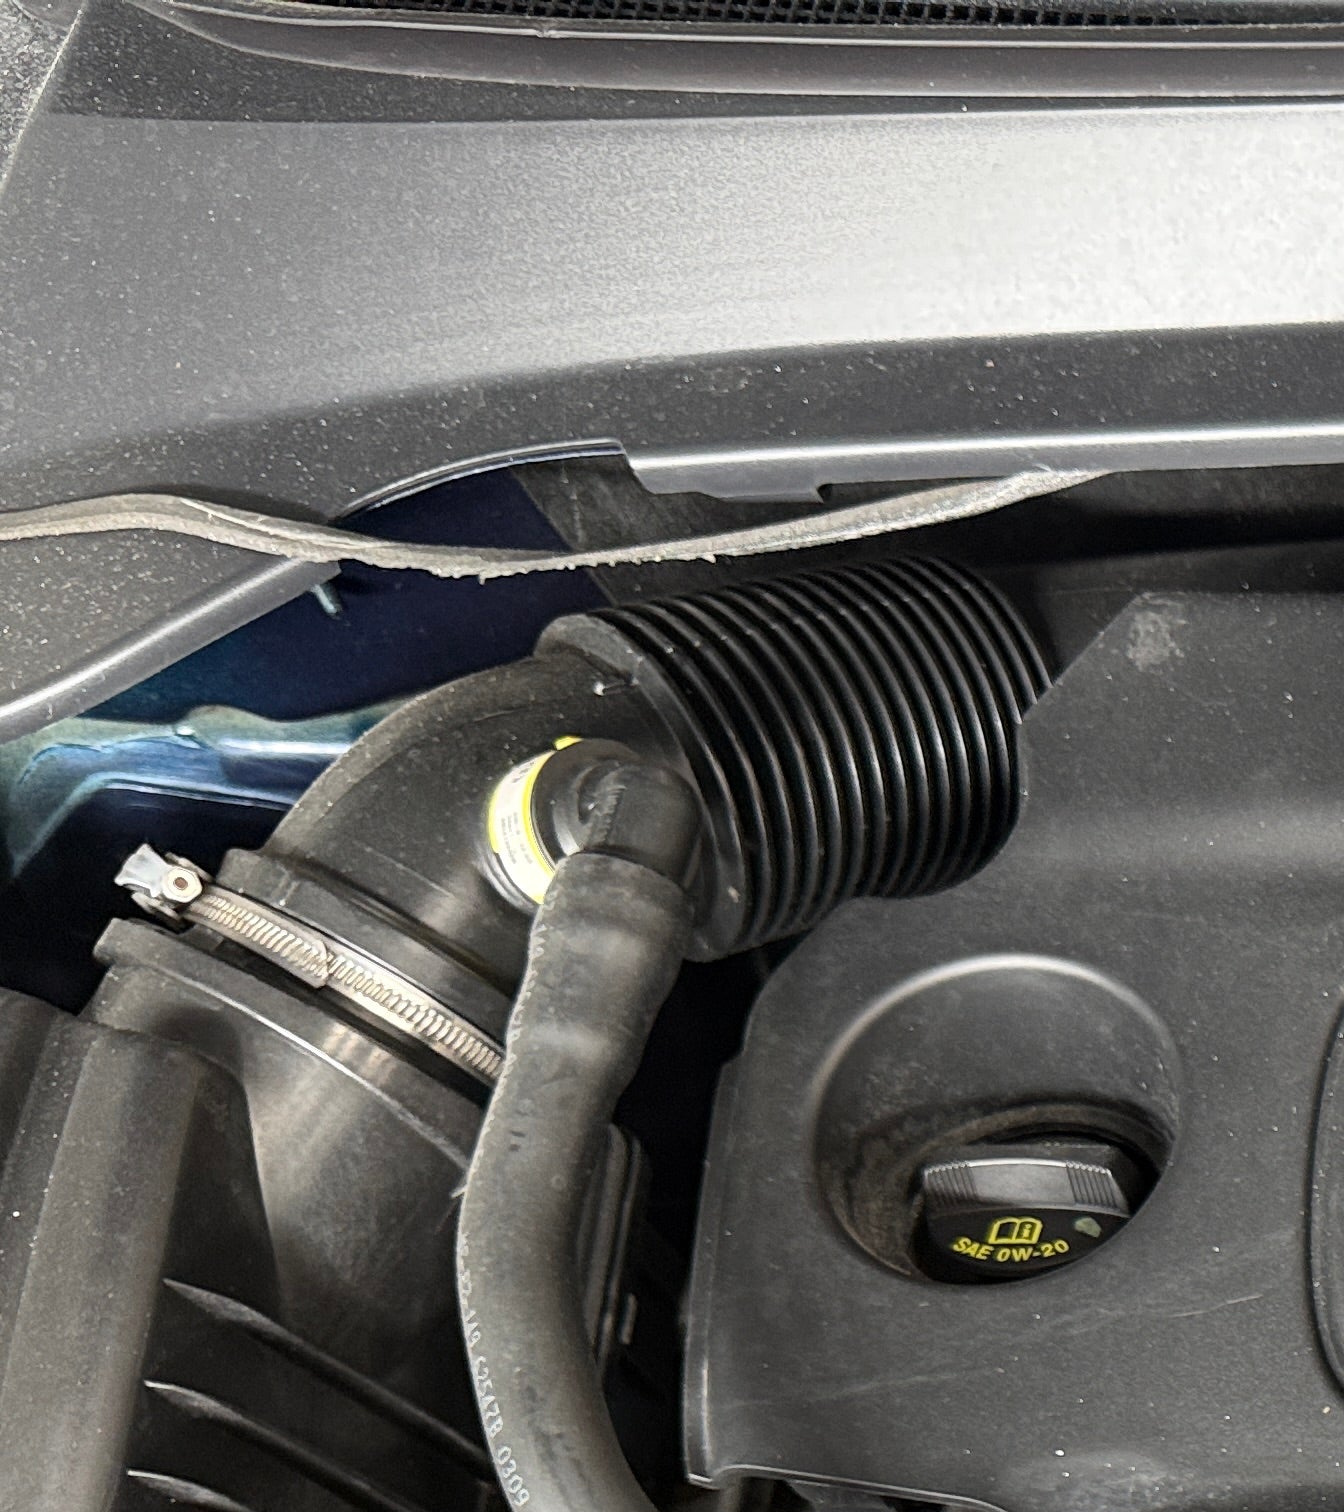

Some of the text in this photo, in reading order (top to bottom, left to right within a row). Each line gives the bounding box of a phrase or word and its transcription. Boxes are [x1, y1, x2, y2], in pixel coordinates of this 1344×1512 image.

[952, 1236, 1070, 1263] SAE 0W-20
[497, 1445, 530, 1507] 0309
